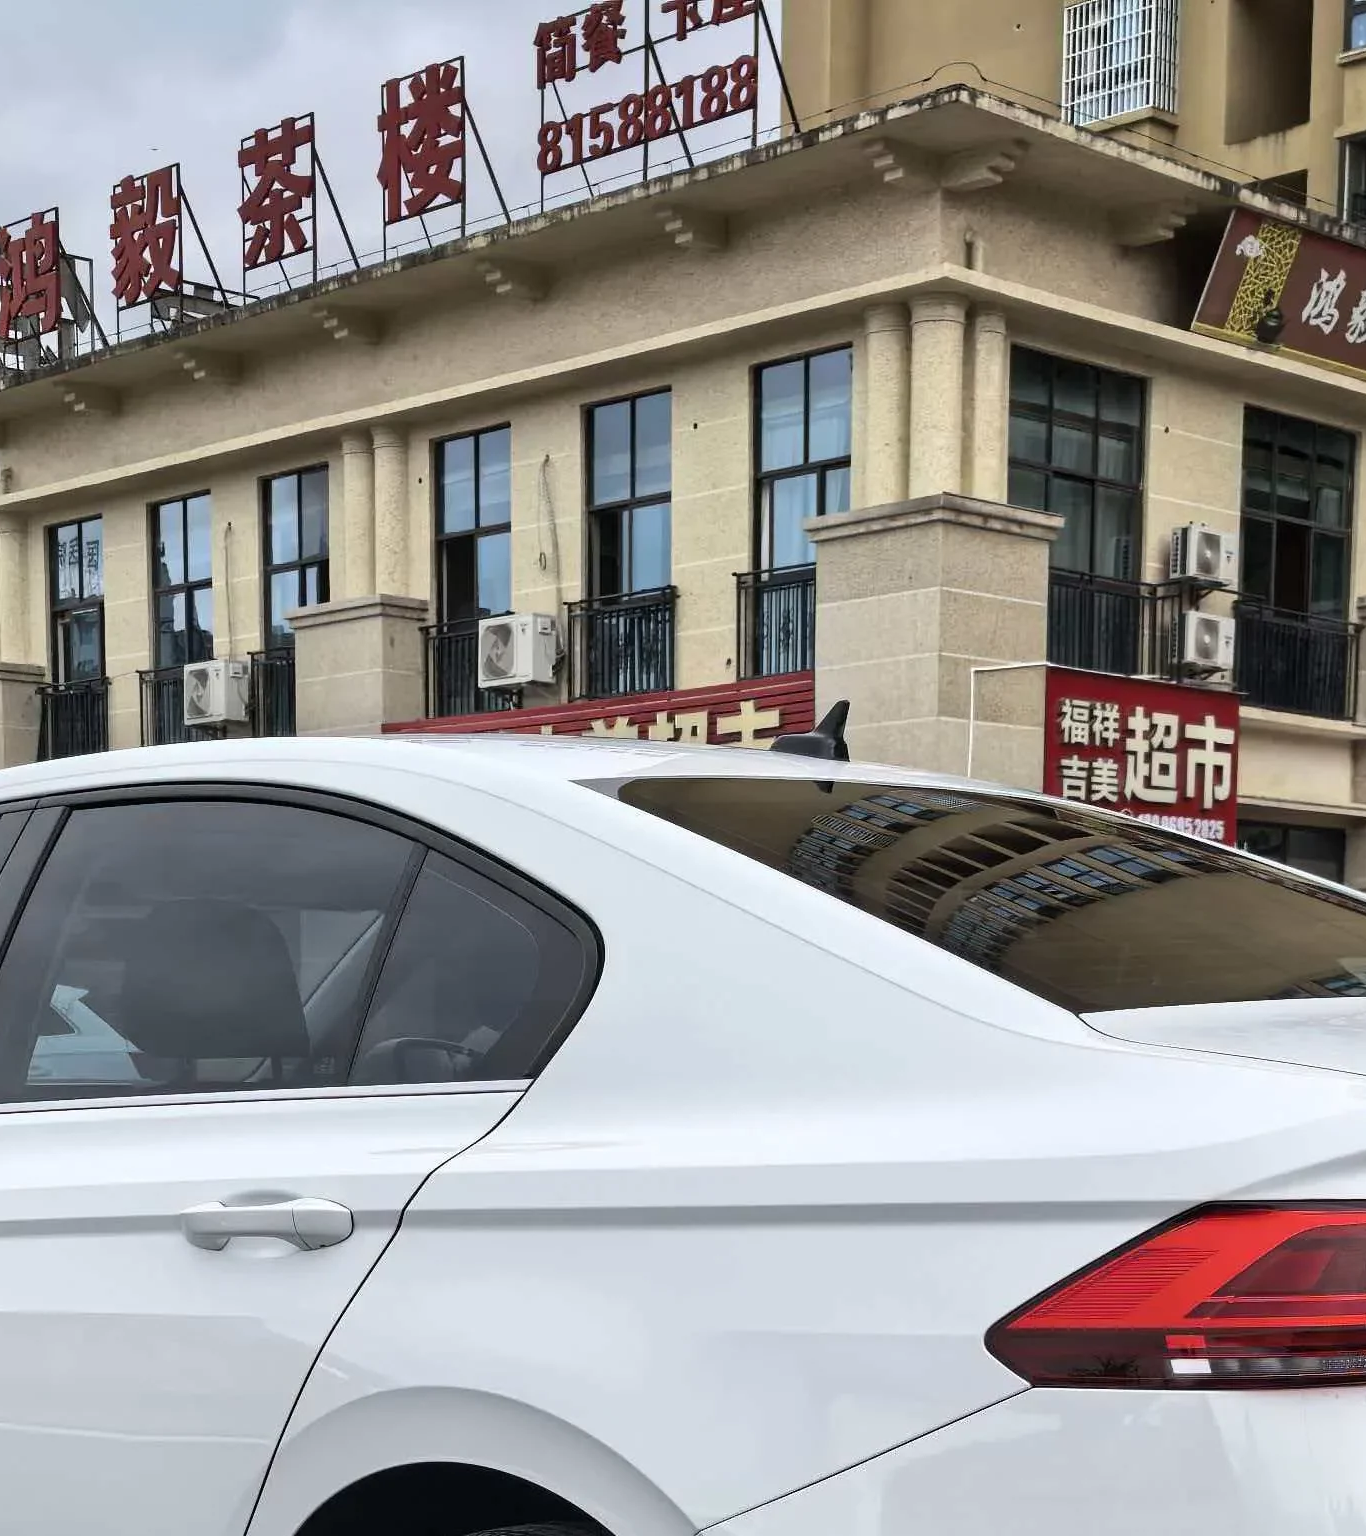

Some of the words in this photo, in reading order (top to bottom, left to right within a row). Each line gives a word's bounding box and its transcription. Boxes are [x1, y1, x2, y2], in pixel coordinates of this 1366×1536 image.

[537, 55, 758, 174] 81588188
[1061, 698, 1120, 747] 福祥
[1125, 706, 1235, 809] 超市
[1060, 755, 1119, 802] 吉美
